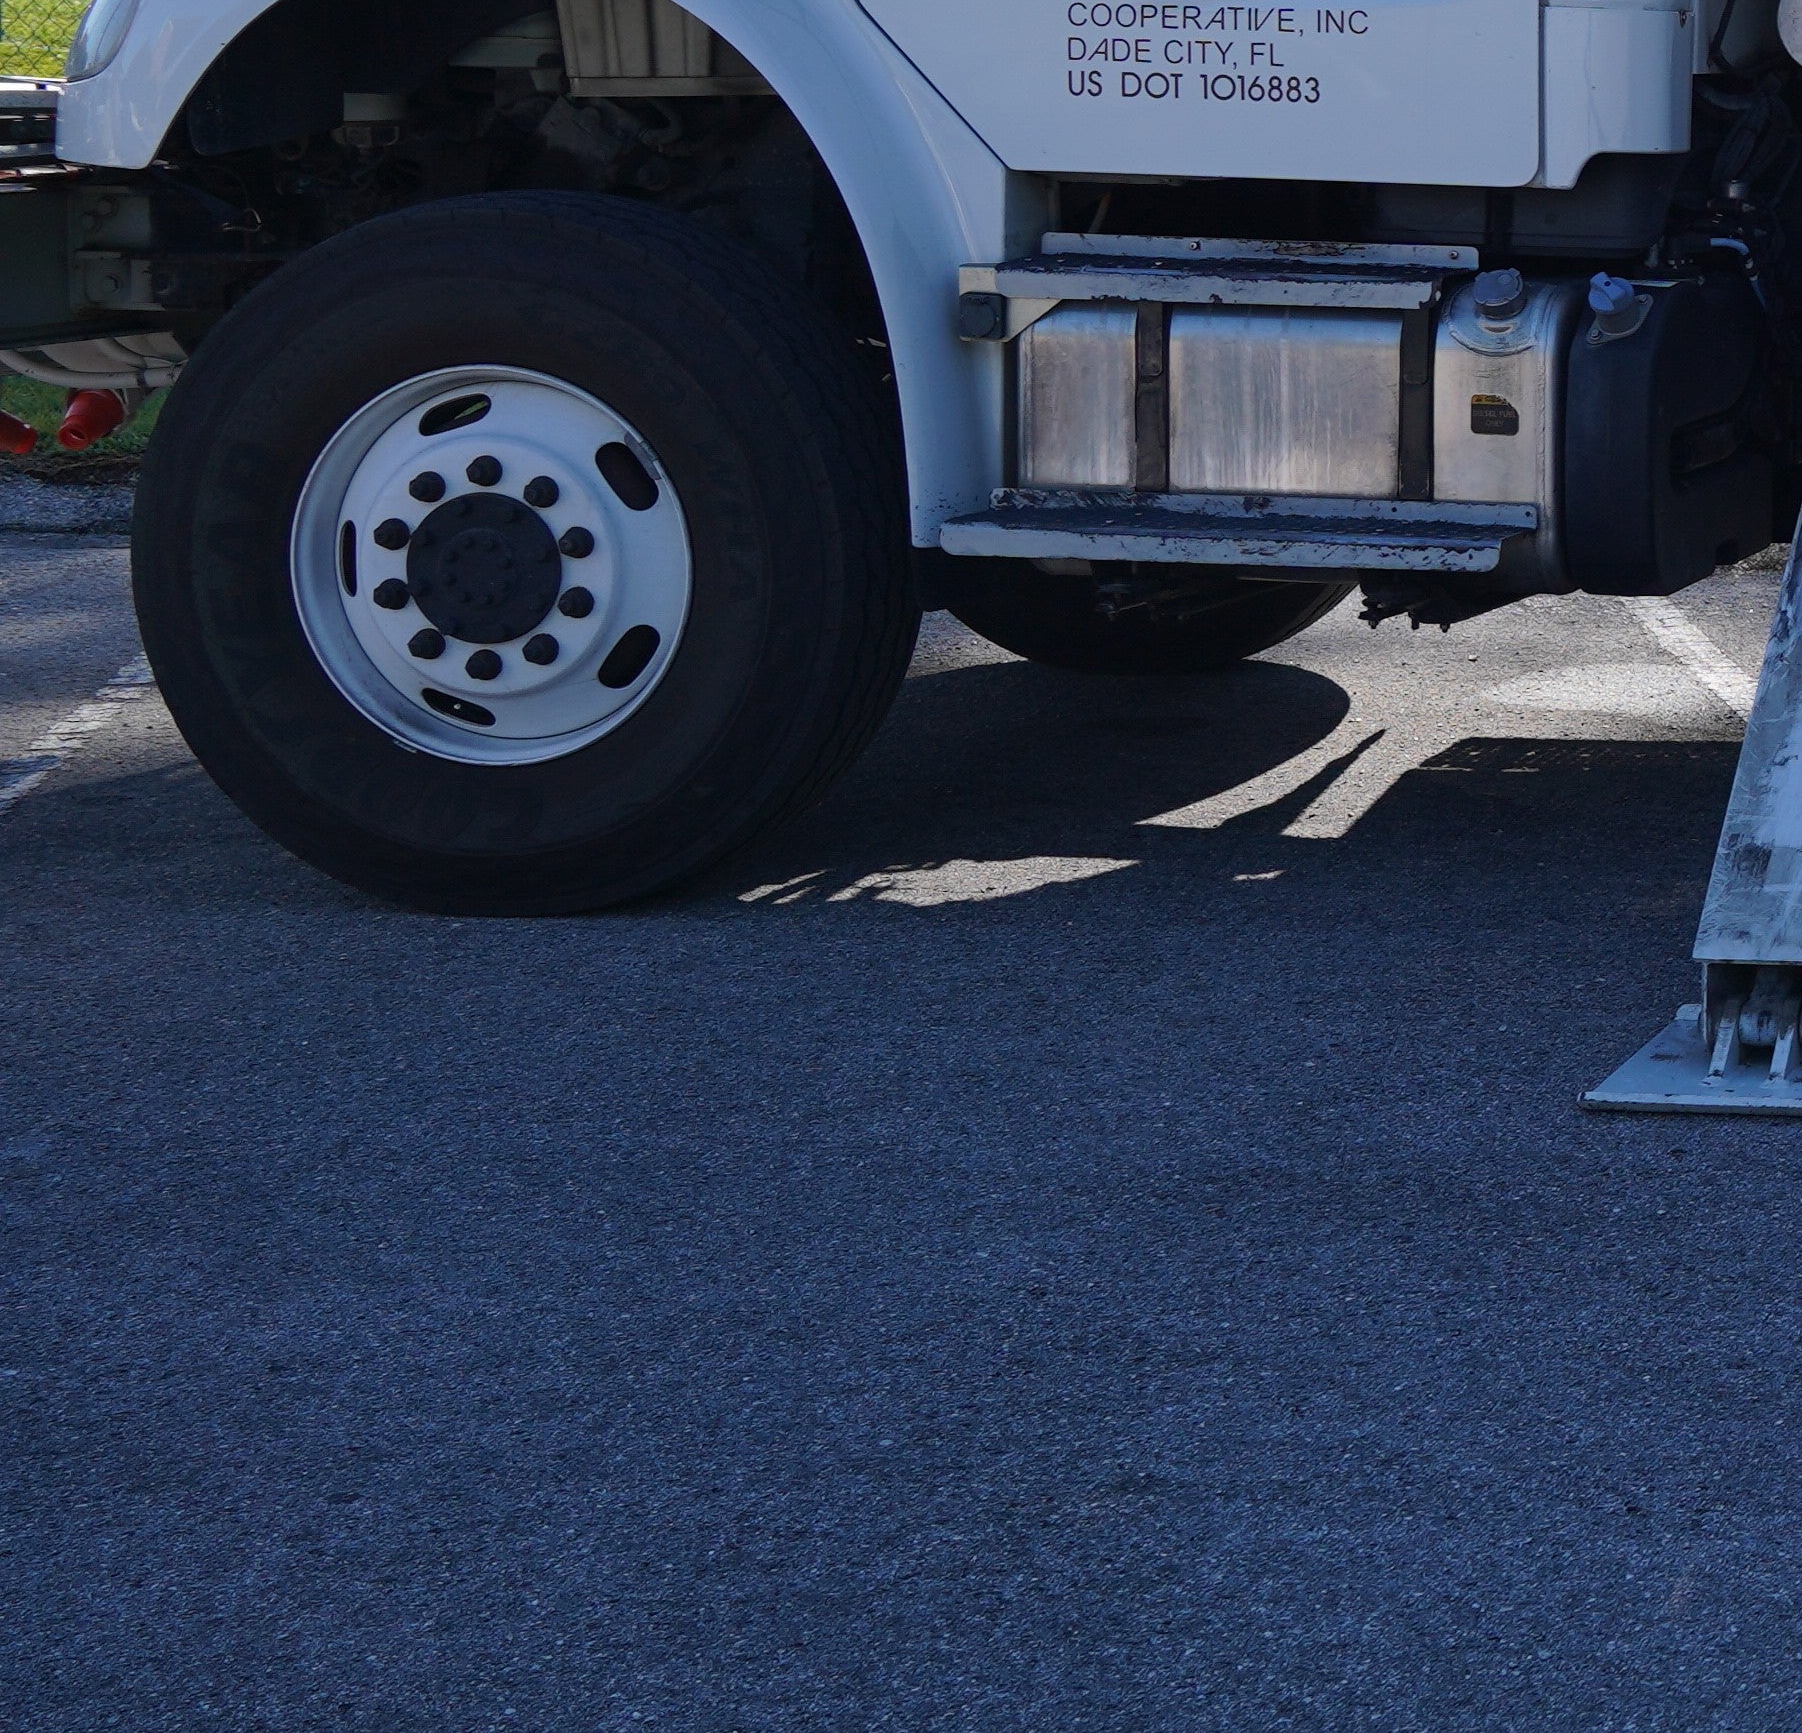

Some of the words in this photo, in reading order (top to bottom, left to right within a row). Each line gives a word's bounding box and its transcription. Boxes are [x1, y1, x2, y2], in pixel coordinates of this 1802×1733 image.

[1067, 2, 1304, 37] COOPERATIVE,
[1316, 9, 1369, 34] INC
[1067, 37, 1152, 63] DADE
[1164, 39, 1237, 69] CITY,
[1250, 42, 1284, 66] FL
[1067, 70, 1102, 97] US
[1121, 71, 1183, 98] DOT
[1200, 73, 1321, 103] 1016883
